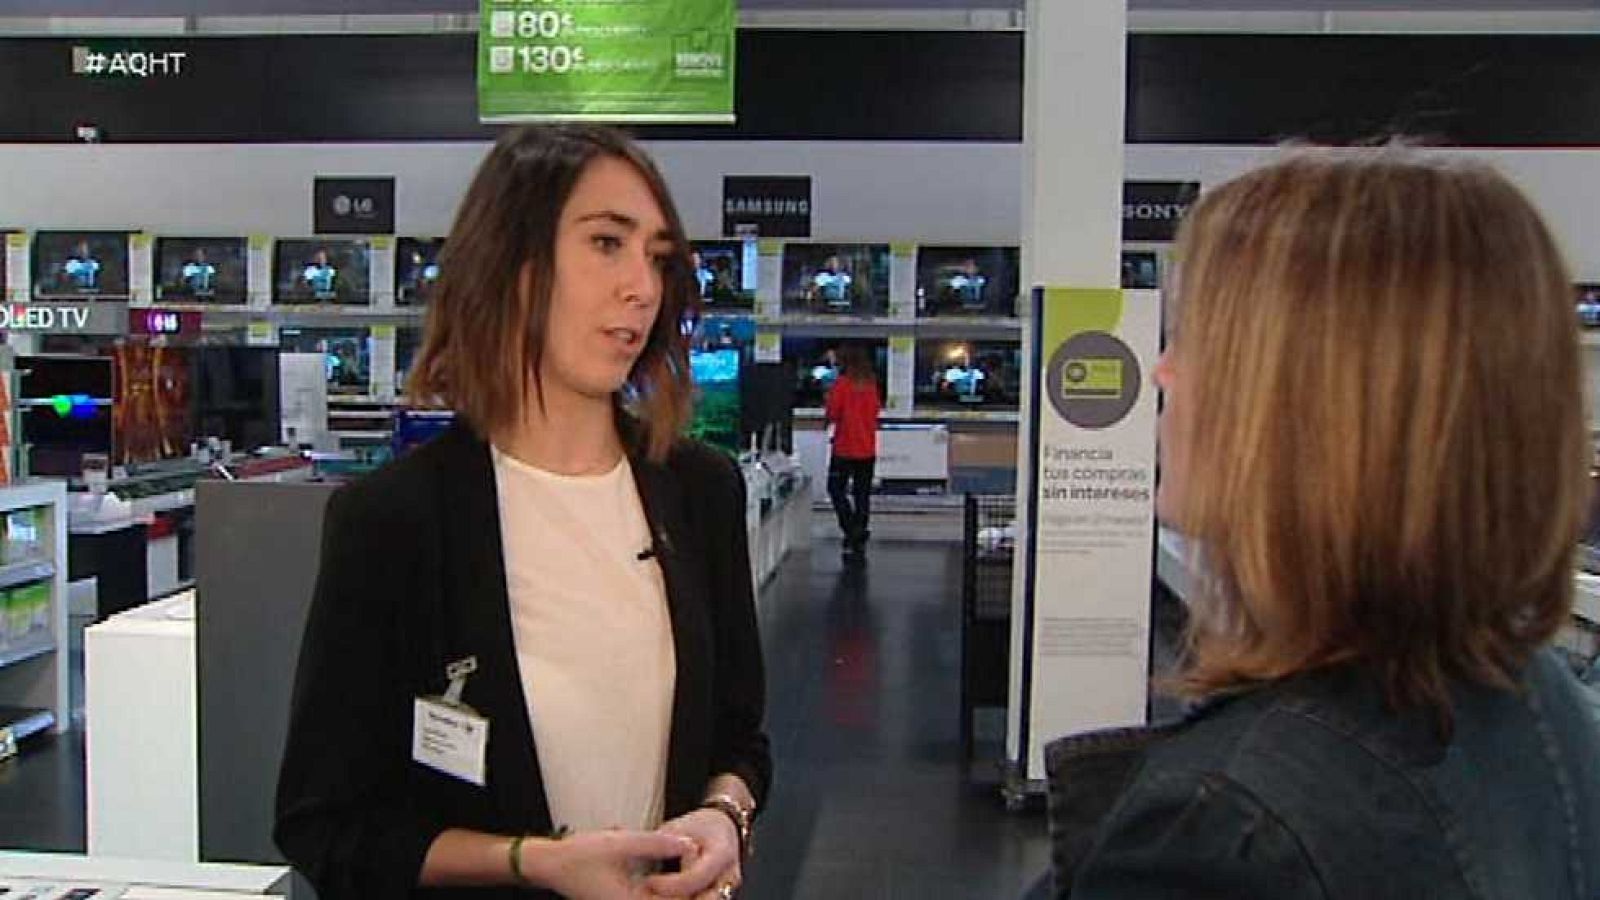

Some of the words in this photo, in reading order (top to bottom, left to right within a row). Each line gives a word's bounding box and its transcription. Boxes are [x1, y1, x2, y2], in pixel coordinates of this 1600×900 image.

[725, 198, 809, 215] SAMSUNG
[57, 306, 89, 328] TV
[1044, 465, 1069, 479] tus
[1073, 468, 1147, 484] compras
[1043, 486, 1067, 499] sin
[1070, 486, 1150, 501] intereses
